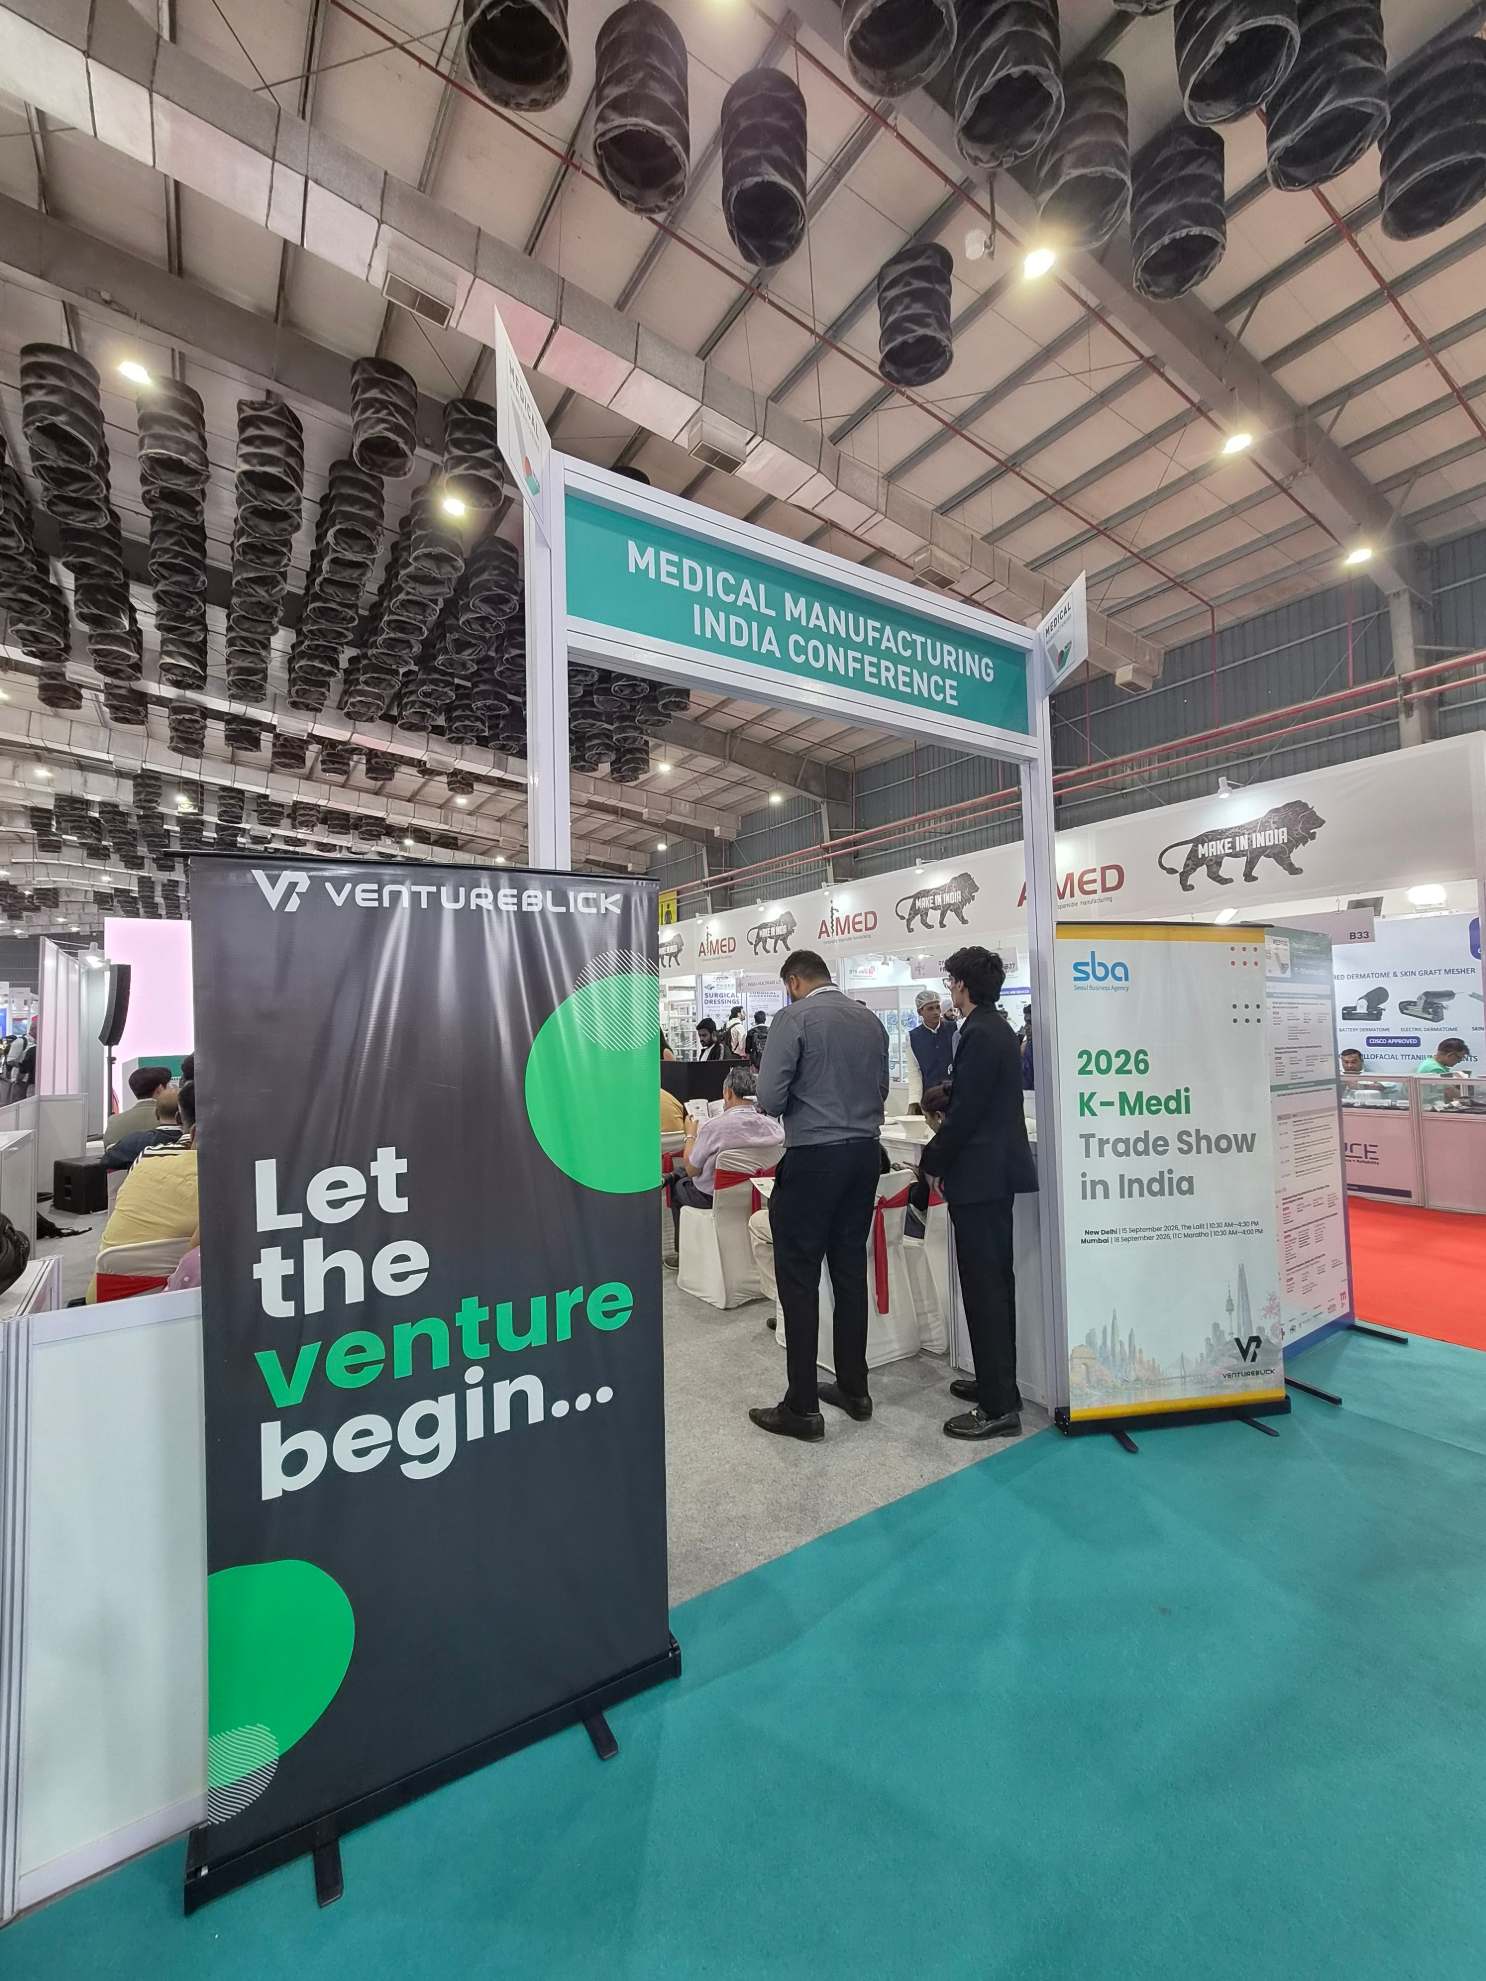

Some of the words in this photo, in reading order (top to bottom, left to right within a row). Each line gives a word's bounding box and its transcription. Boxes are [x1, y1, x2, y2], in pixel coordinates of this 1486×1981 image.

[628, 540, 776, 617] MEDICAL
[784, 591, 994, 682] MANUFACTURING
[1045, 602, 1072, 638] MEDICAL
[693, 603, 781, 658] INDIA
[788, 633, 959, 706] CONFERENCE
[1198, 837, 1233, 859] MAKE
[1235, 834, 1249, 852] IN
[1252, 827, 1288, 849] INDIA
[324, 881, 622, 915] VENTUREBLICK
[915, 895, 934, 910] MAKE
[934, 893, 942, 906] IN
[943, 890, 962, 905] INDIA
[1349, 931, 1369, 941] B33
[1072, 950, 1129, 982] sba
[1347, 972, 1390, 981] DERMATOME
[1400, 969, 1417, 978] SKIN
[1418, 969, 1442, 977] GRAFT
[1444, 967, 1476, 976] MESHER
[1077, 1049, 1150, 1076] 2026
[1079, 1130, 1170, 1159] Trade
[1177, 1128, 1257, 1157] Show
[255, 1147, 409, 1232] Let
[1081, 1171, 1110, 1200] in
[1119, 1169, 1195, 1198] India
[1121, 1234, 1155, 1244] September
[1129, 1226, 1162, 1235] September
[253, 1237, 430, 1318] the
[254, 1281, 634, 1408] venture
[259, 1365, 614, 1501] begin...
